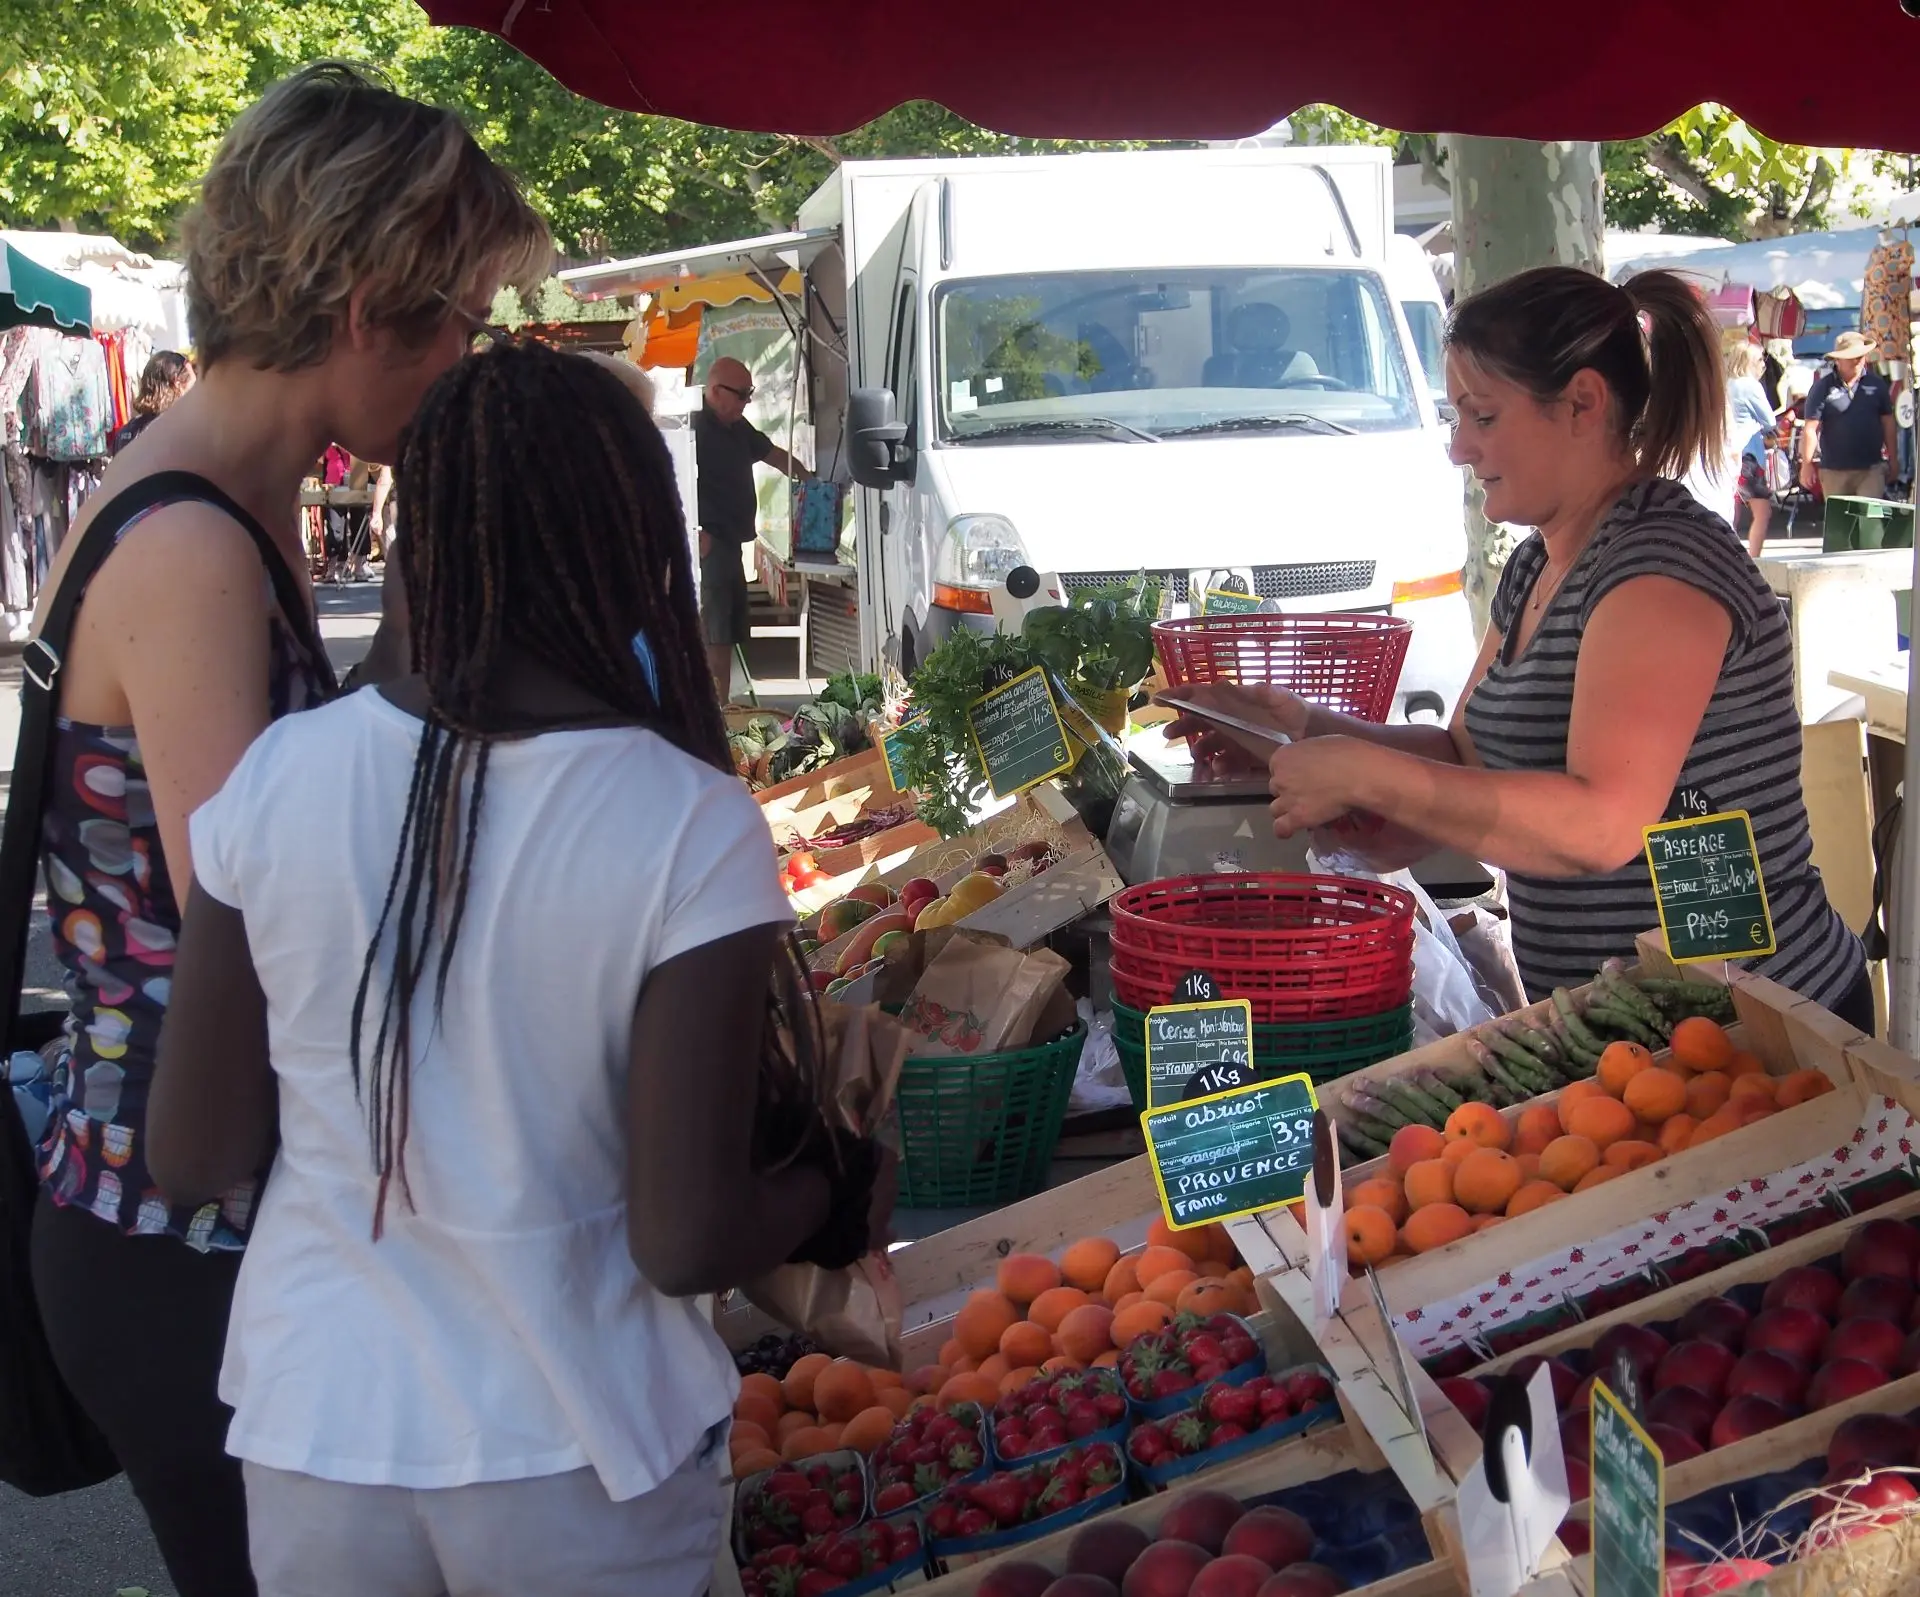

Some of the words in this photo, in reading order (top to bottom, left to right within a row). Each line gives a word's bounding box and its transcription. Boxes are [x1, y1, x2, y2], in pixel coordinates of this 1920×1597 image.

[1033, 703, 1053, 725] 4,50
[1664, 833, 1726, 861] ASPERGE
[1673, 879, 1699, 894] France
[1686, 909, 1730, 941] PAYS
[1158, 1019, 1197, 1041] Cerise
[1148, 1114, 1177, 1126] Produit
[1185, 1092, 1270, 1129] abricot
[1272, 1119, 1314, 1145] 3,9
[1178, 1151, 1300, 1194] PROVENCE
[1175, 1193, 1227, 1216] France
